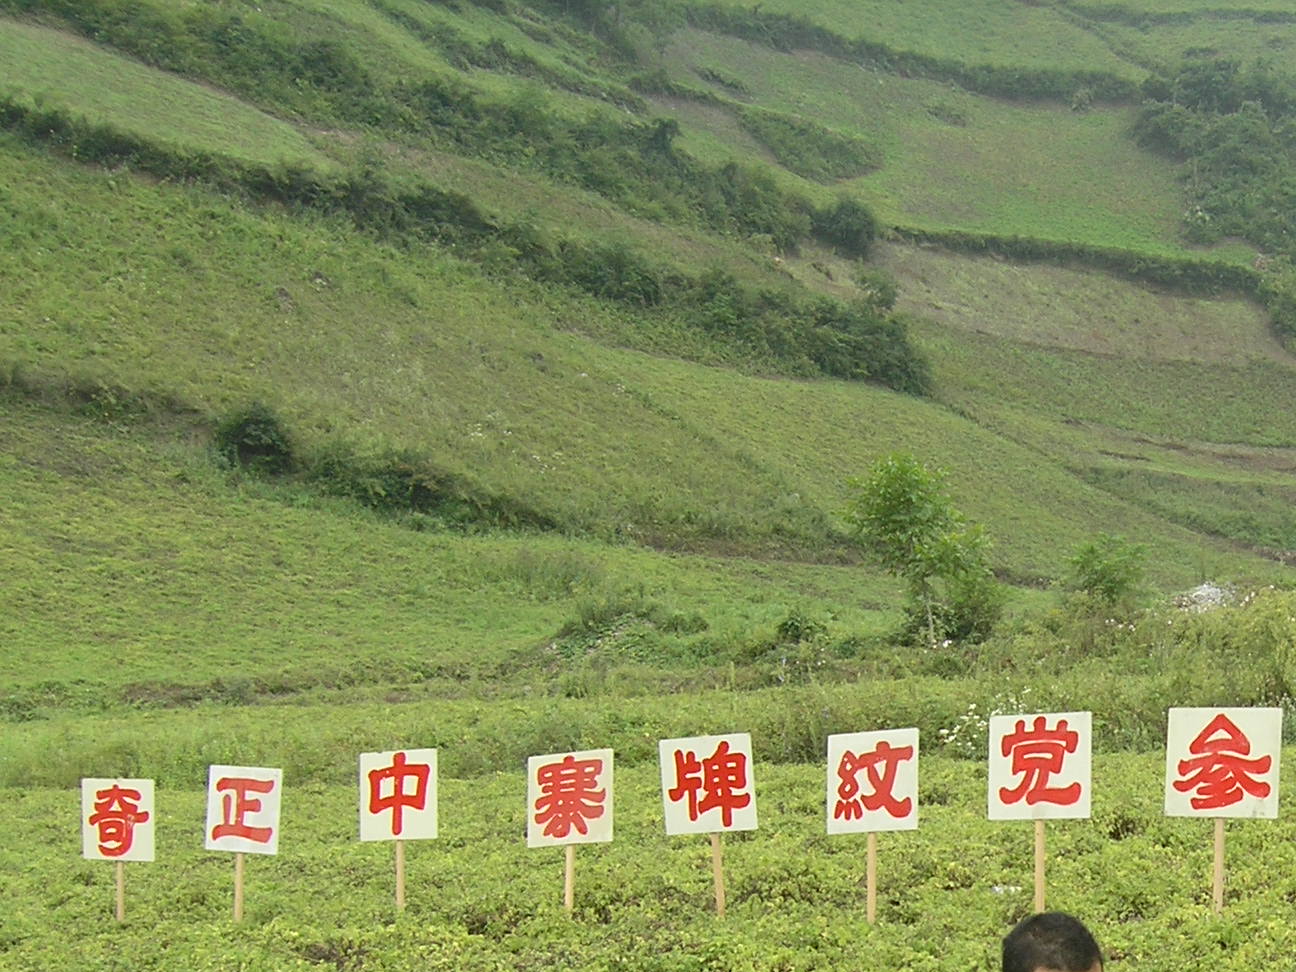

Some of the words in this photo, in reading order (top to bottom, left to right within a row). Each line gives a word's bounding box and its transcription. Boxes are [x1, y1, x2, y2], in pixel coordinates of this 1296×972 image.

[368, 752, 430, 835] 中
[535, 756, 605, 838] 寨
[668, 741, 751, 827] 牌
[999, 717, 1082, 806] 党
[1173, 714, 1272, 810] 参
[89, 786, 149, 857] 奇
[212, 778, 274, 843] 正
